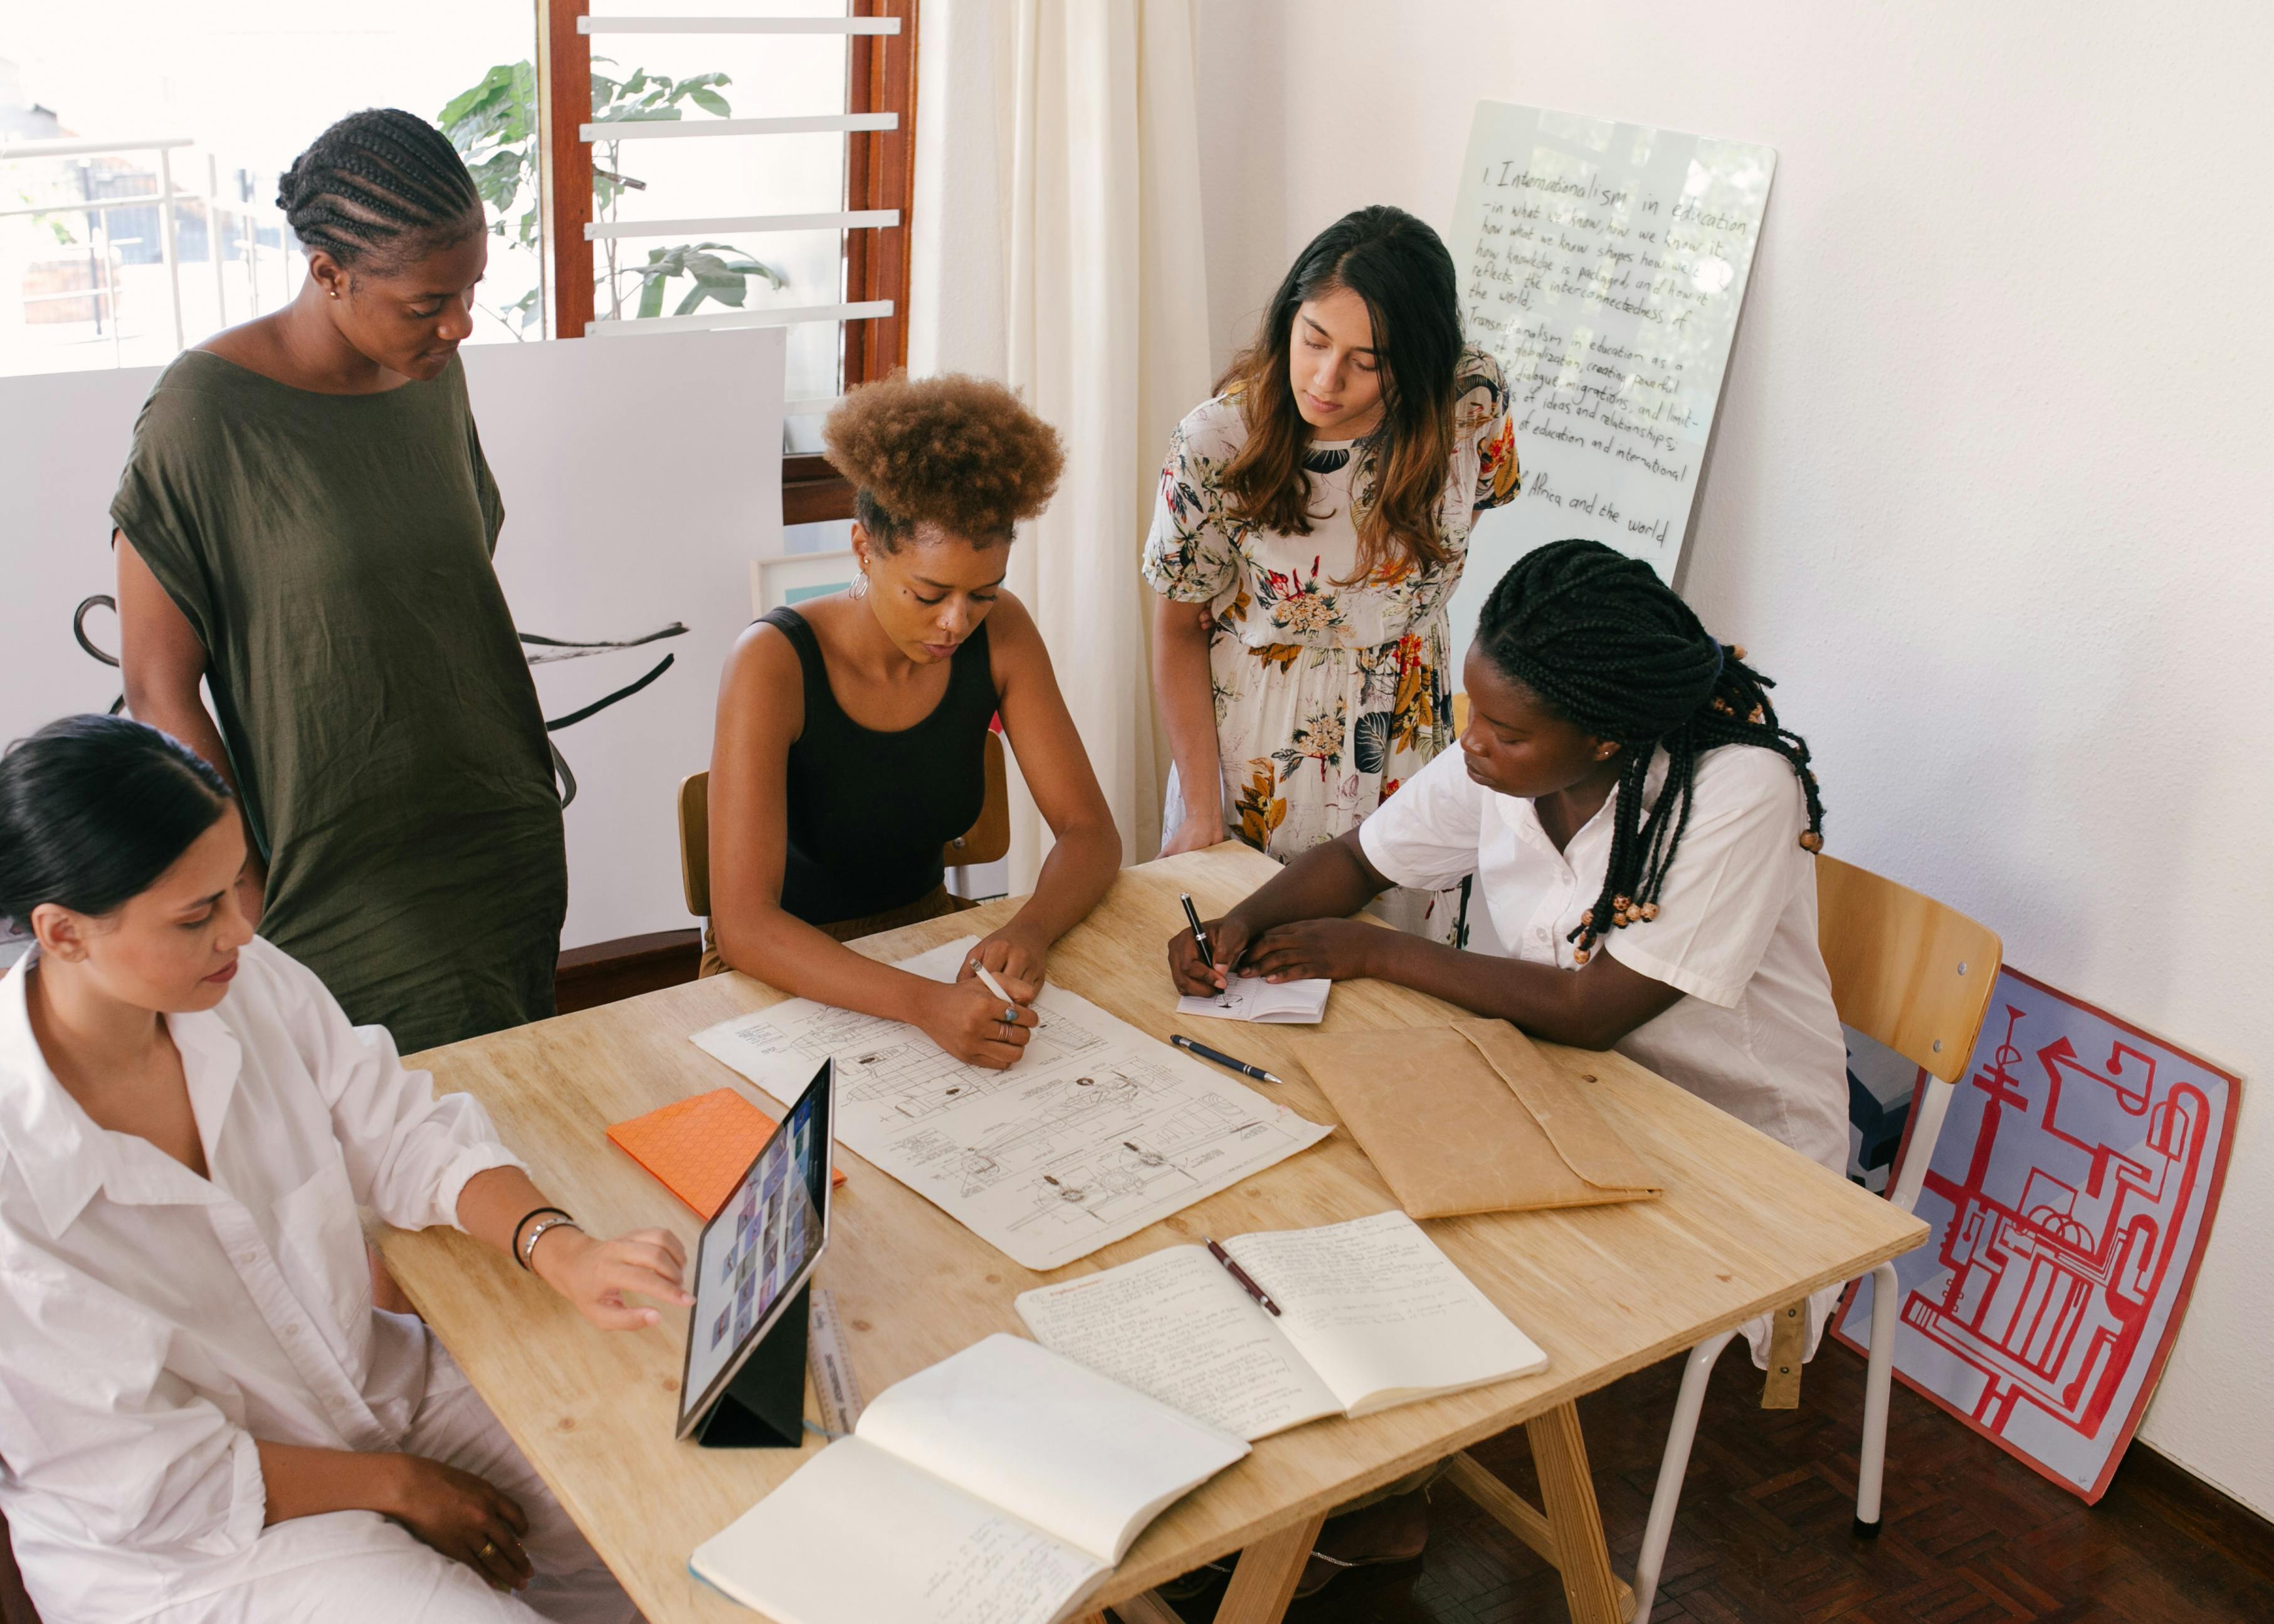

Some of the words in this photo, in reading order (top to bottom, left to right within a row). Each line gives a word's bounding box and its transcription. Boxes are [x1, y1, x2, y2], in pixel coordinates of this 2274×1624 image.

[1497, 161, 1627, 209] Internationalism
[1642, 193, 1659, 215] in
[1672, 196, 1746, 235] education
[1511, 201, 1540, 219] what
[1547, 212, 1562, 224] we
[1606, 217, 1629, 238] how
[1639, 230, 1656, 243] we
[1665, 229, 1702, 251] know
[1475, 238, 1500, 259] how
[1507, 246, 1553, 278] knowledge
[1561, 261, 1570, 275] is
[1636, 278, 1666, 295] and
[1668, 281, 1692, 300] how
[1697, 291, 1708, 306] it
[1482, 216, 1502, 234] how
[1509, 223, 1534, 240] what
[1540, 236, 1554, 246] we
[1559, 233, 1589, 253] know
[1597, 243, 1634, 266] shapes
[1640, 251, 1665, 269] how
[1671, 263, 1687, 274] we
[1468, 281, 1487, 299] the
[1472, 261, 1513, 284] reflects
[1524, 272, 1540, 289] the
[1550, 280, 1663, 323] interconnectedness
[1673, 310, 1692, 330] of
[1468, 306, 1562, 346] Transnationalism
[1571, 334, 1581, 348] in
[1589, 335, 1643, 361] education
[1652, 357, 1666, 369] as
[1495, 335, 1508, 354] of
[1630, 374, 1680, 394] powerful
[1524, 387, 1535, 403] of
[1543, 393, 1570, 414] ideas
[1576, 401, 1599, 419] and
[1638, 401, 1663, 421] and
[1519, 409, 1535, 431] of
[1533, 417, 1584, 447] education
[1592, 436, 1614, 453] and
[1616, 444, 1687, 482] international
[1528, 472, 1561, 507] Africa
[1569, 493, 1597, 516] and
[1599, 503, 1619, 522] the
[1628, 519, 1669, 548] world
